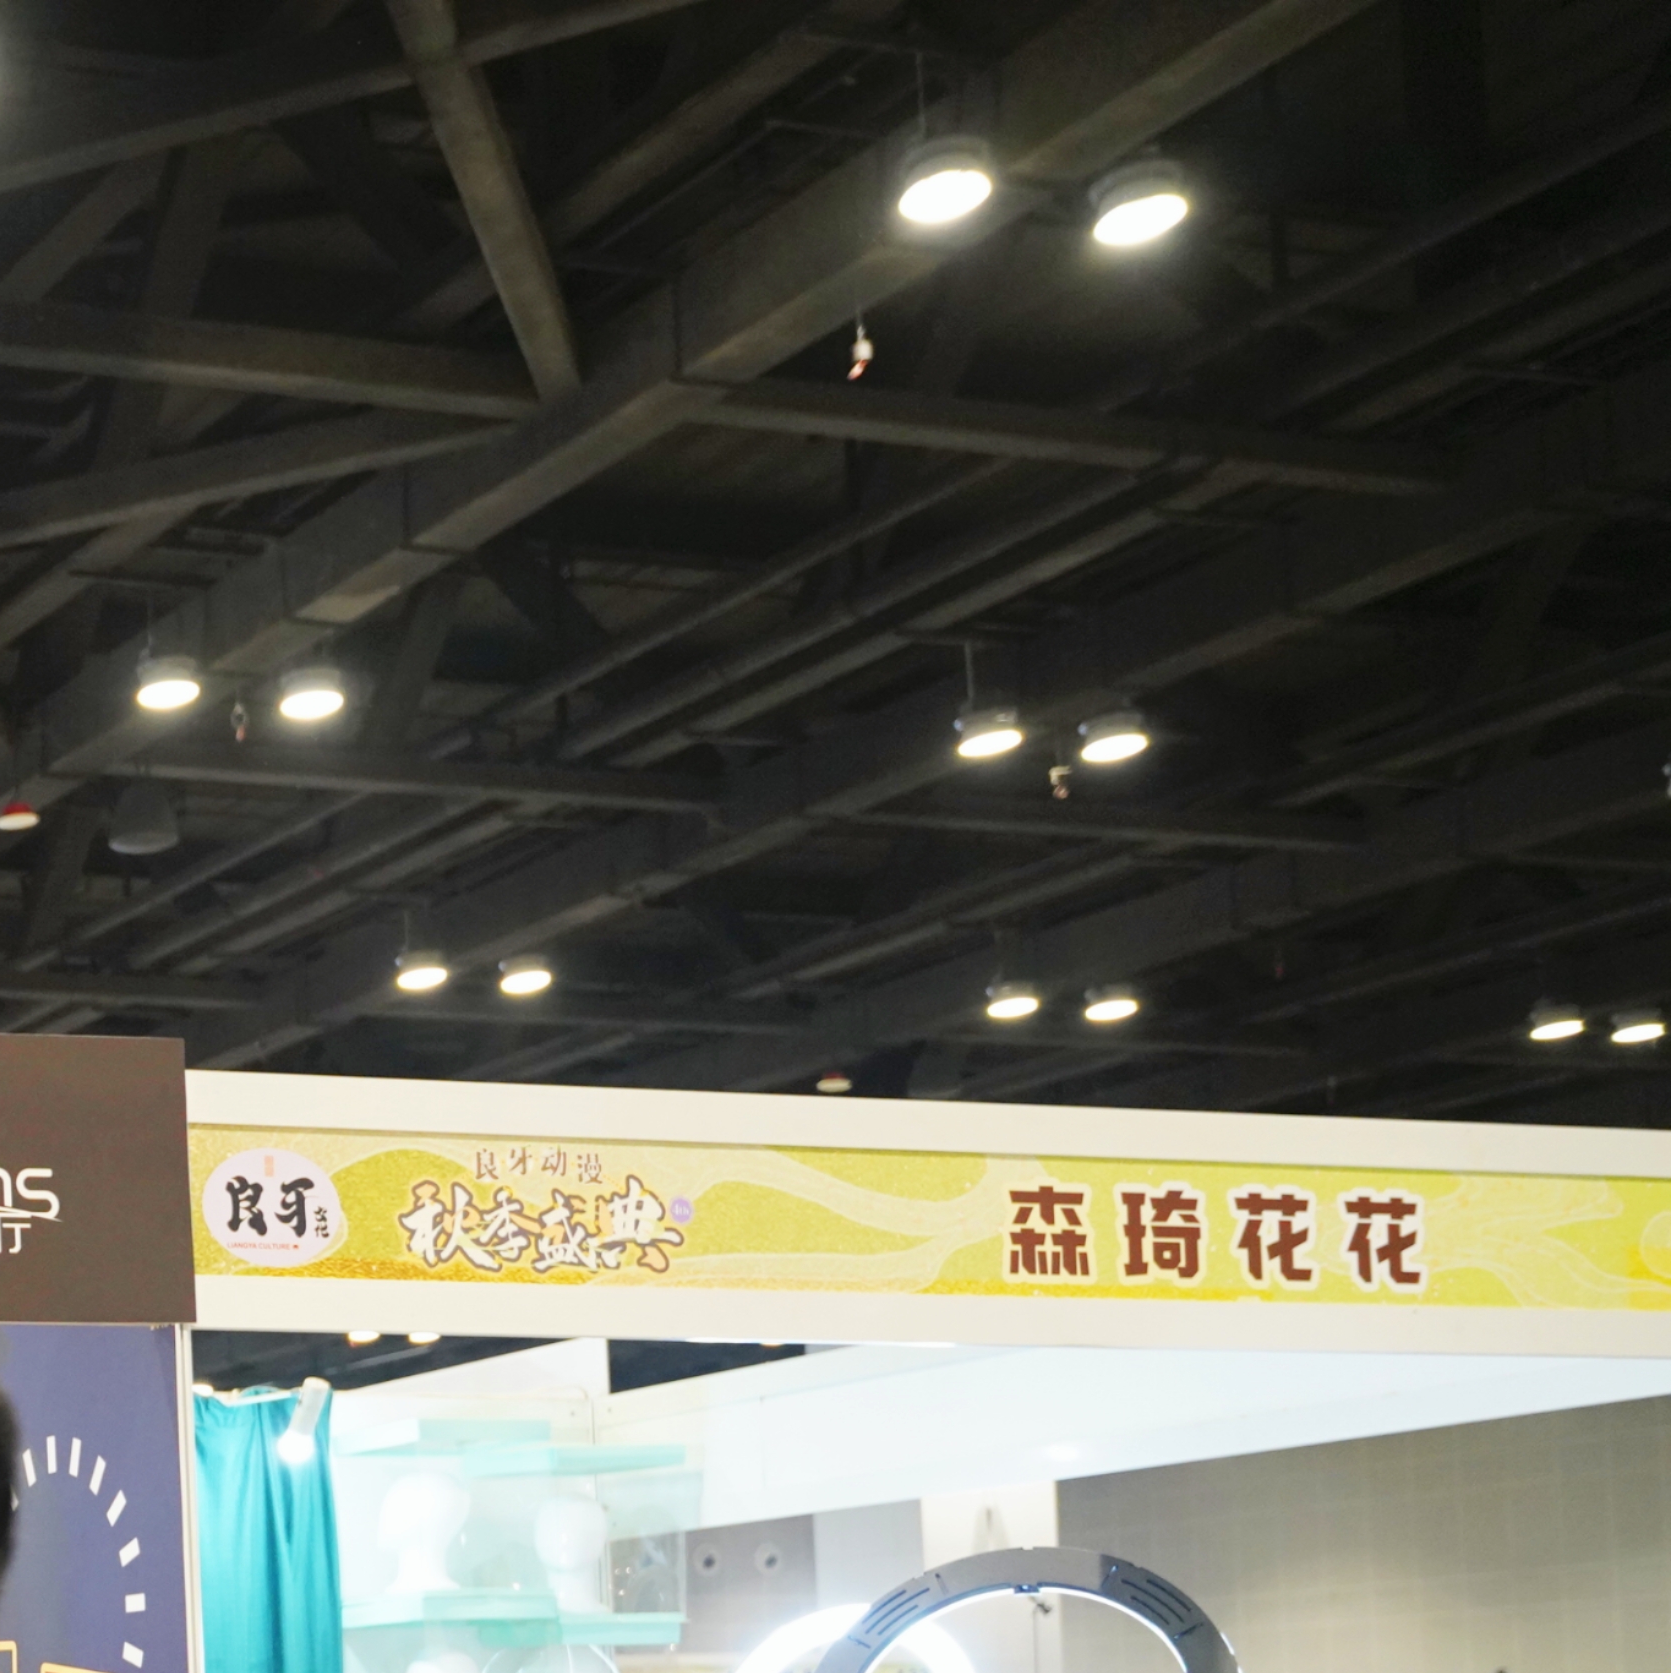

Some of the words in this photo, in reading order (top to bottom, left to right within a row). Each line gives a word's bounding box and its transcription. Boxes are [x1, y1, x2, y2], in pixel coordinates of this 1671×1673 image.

[475, 1146, 603, 1185] 良牙动漫
[258, 1242, 291, 1251] CULTURE
[398, 1173, 684, 1274] 秋季盛典
[1008, 1185, 1422, 1284] 森琦花花
